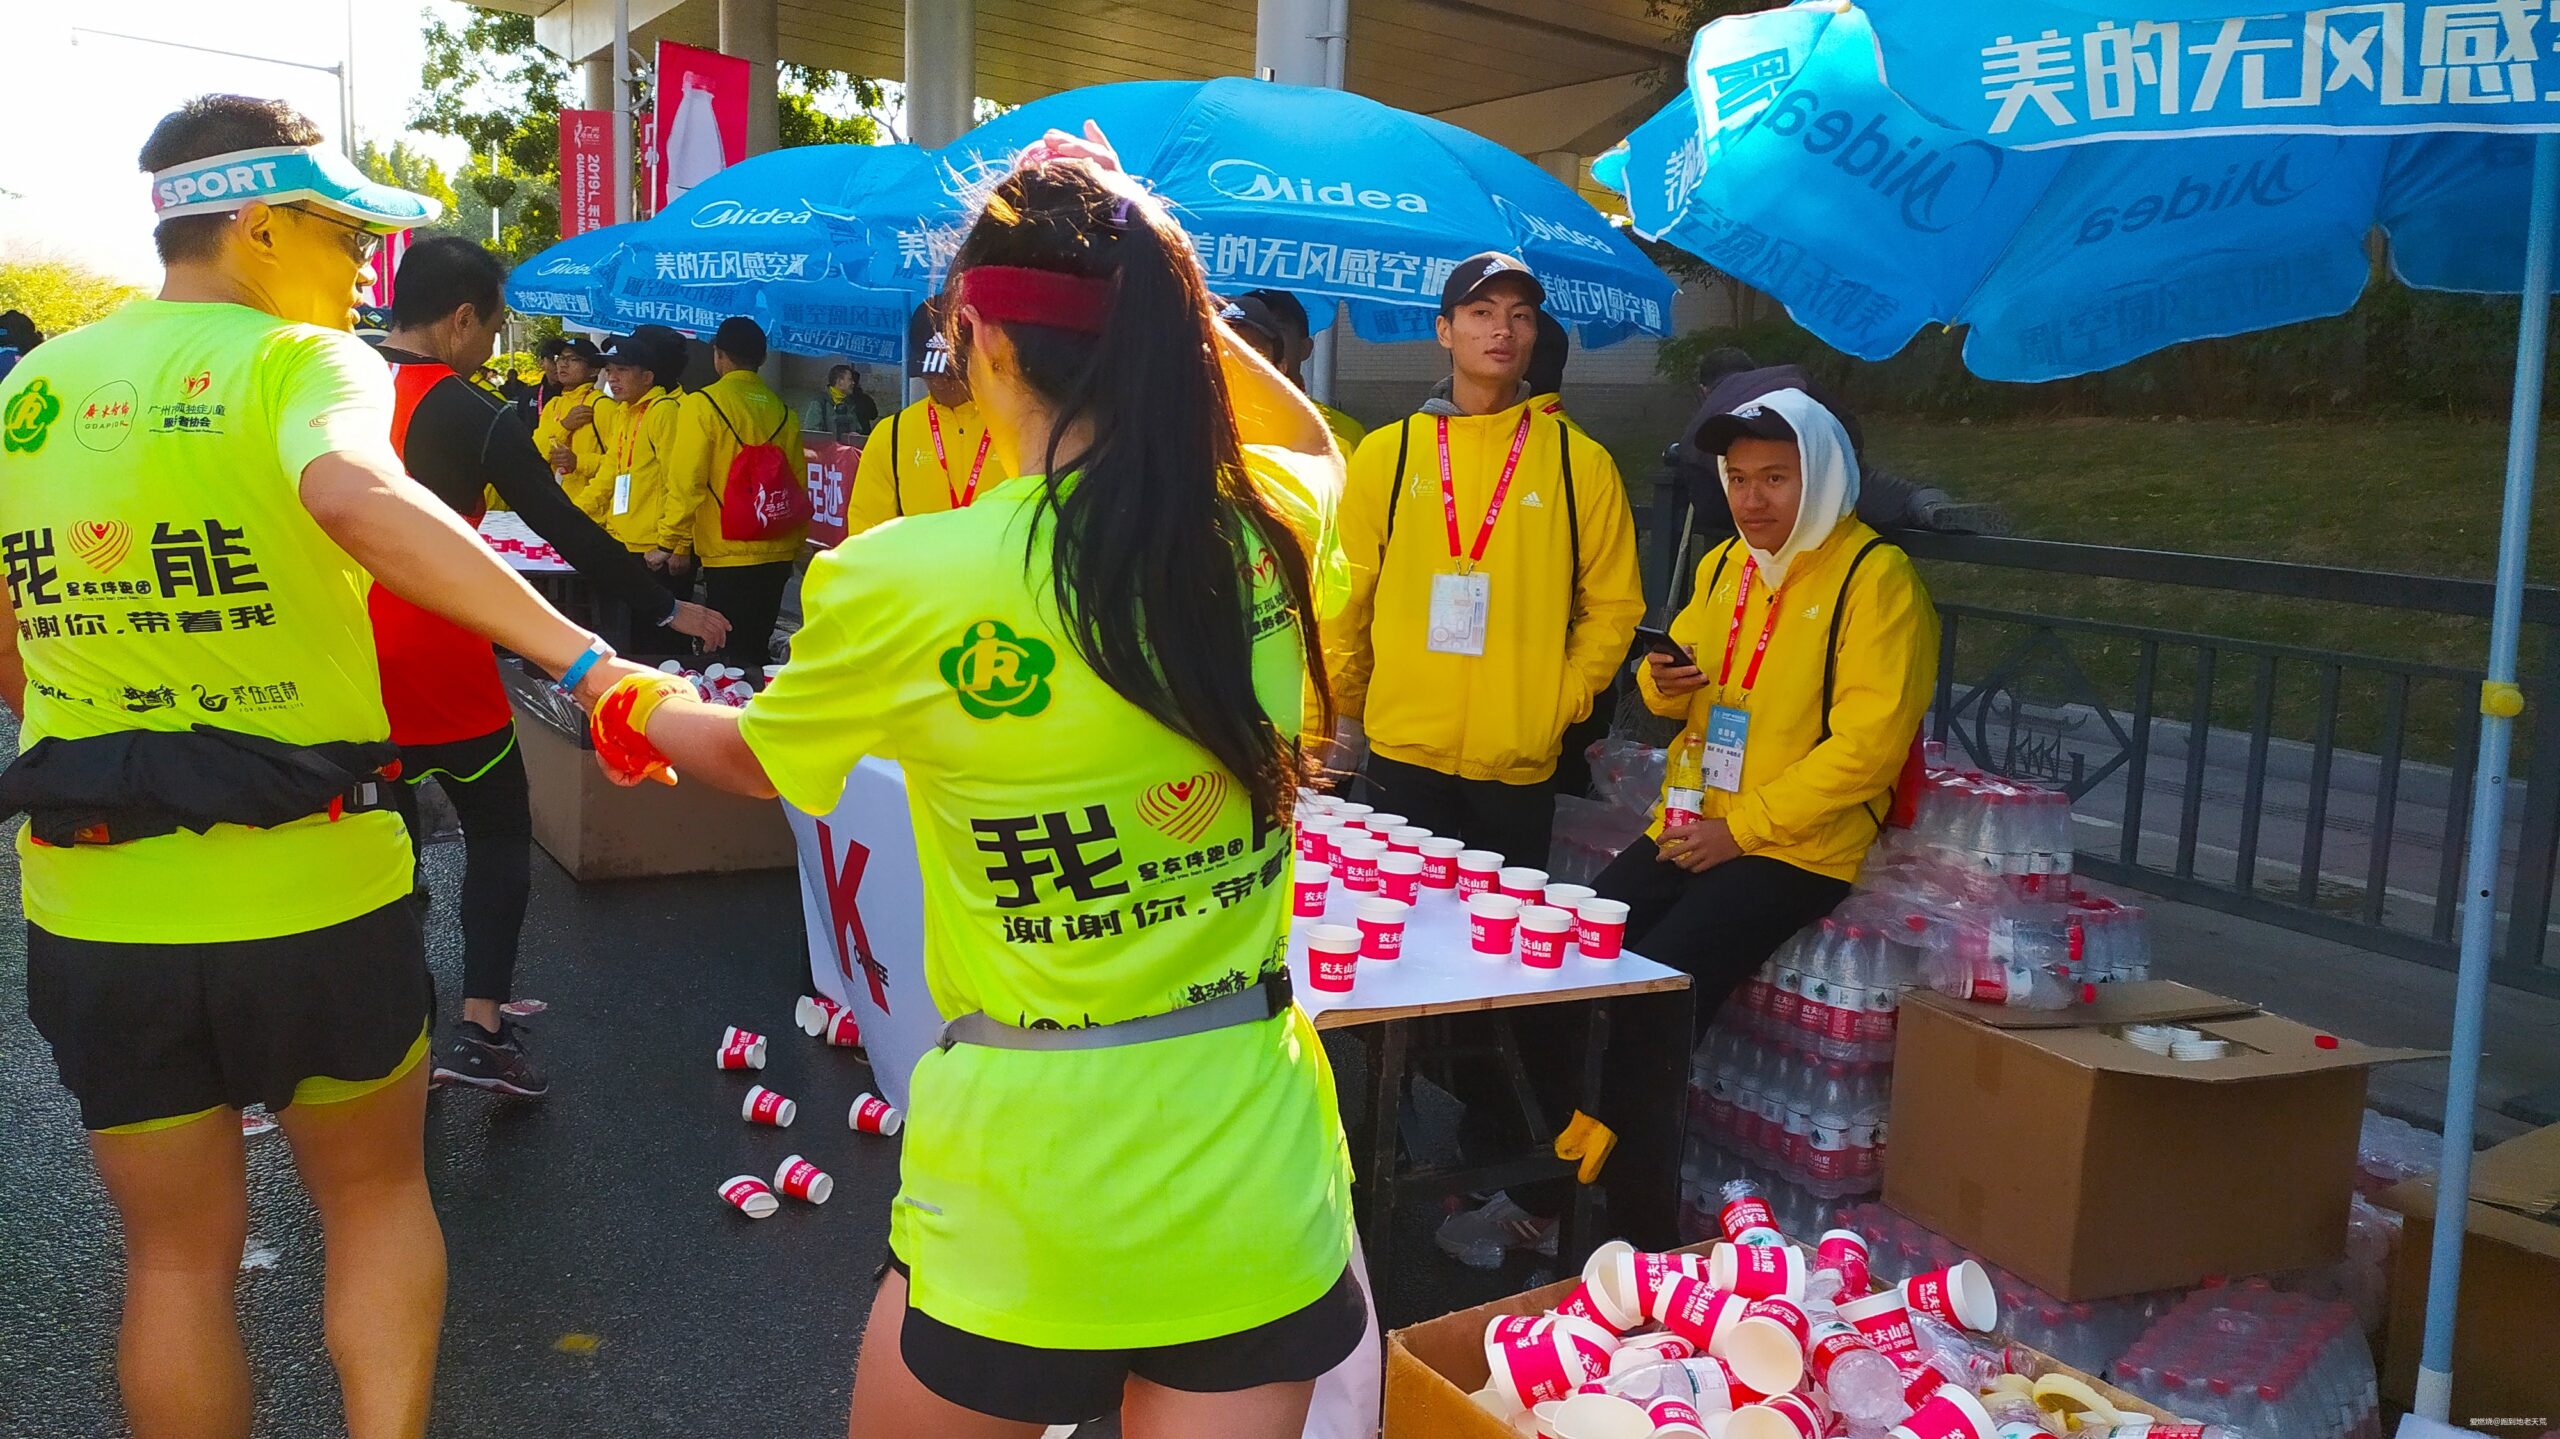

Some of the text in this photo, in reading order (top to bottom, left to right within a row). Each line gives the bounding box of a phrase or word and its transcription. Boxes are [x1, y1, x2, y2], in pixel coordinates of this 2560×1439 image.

[1982, 1, 2560, 133] 美的无风感
[160, 161, 277, 207] SPORT
[1207, 158, 1429, 214] Midea
[691, 200, 812, 229] Midea
[1493, 193, 1616, 257] Midea
[655, 251, 809, 281] 美的无风感空调
[2, 528, 62, 609] 我
[66, 580, 152, 597] 星友伴跑团
[151, 519, 269, 599] 能
[971, 804, 1130, 908] 我
[1138, 838, 1244, 882] 星友伴跑团
[816, 818, 891, 1017] K
